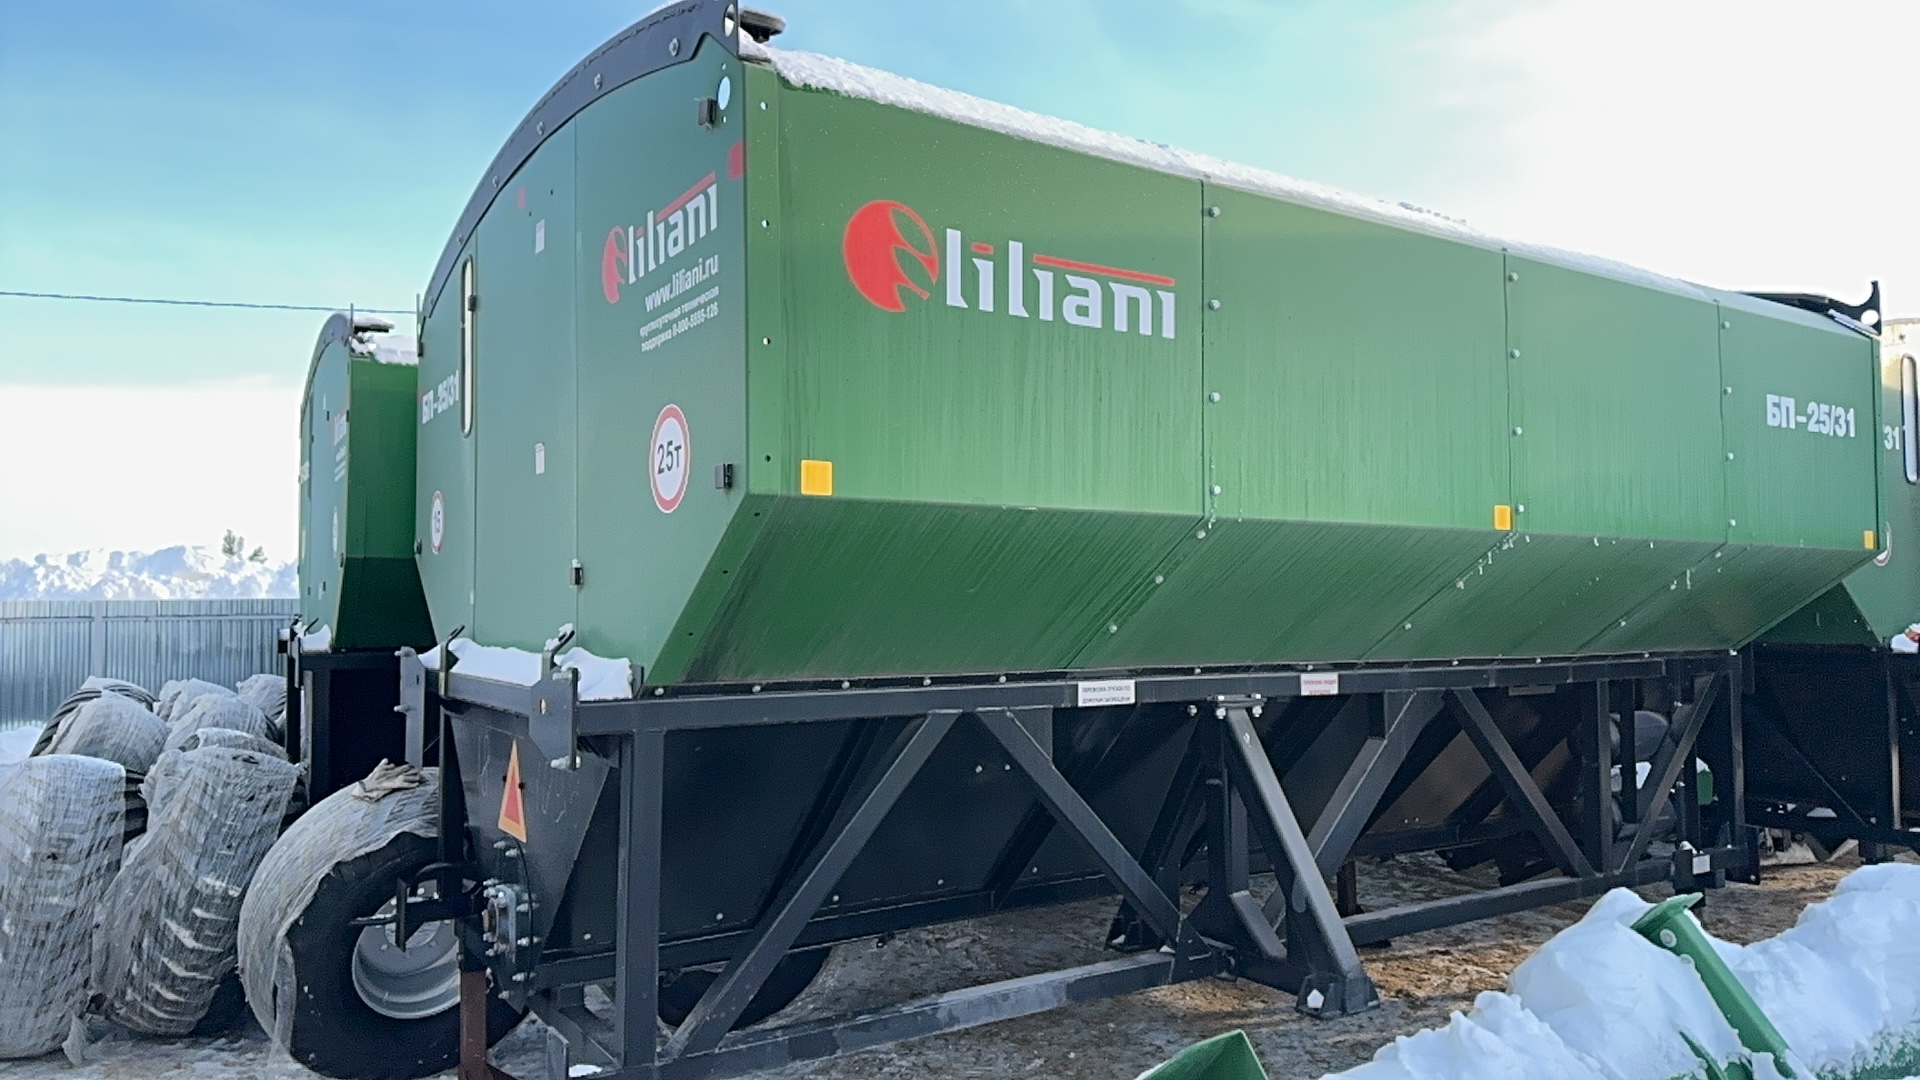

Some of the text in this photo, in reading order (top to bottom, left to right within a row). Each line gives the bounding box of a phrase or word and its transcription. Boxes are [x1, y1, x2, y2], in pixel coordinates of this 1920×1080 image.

[628, 171, 718, 285] liliani
[645, 254, 719, 313] www.liliani.ru
[946, 228, 1175, 339] liliani
[1766, 393, 1856, 438] БП-25/31
[1883, 424, 1901, 450] 31
